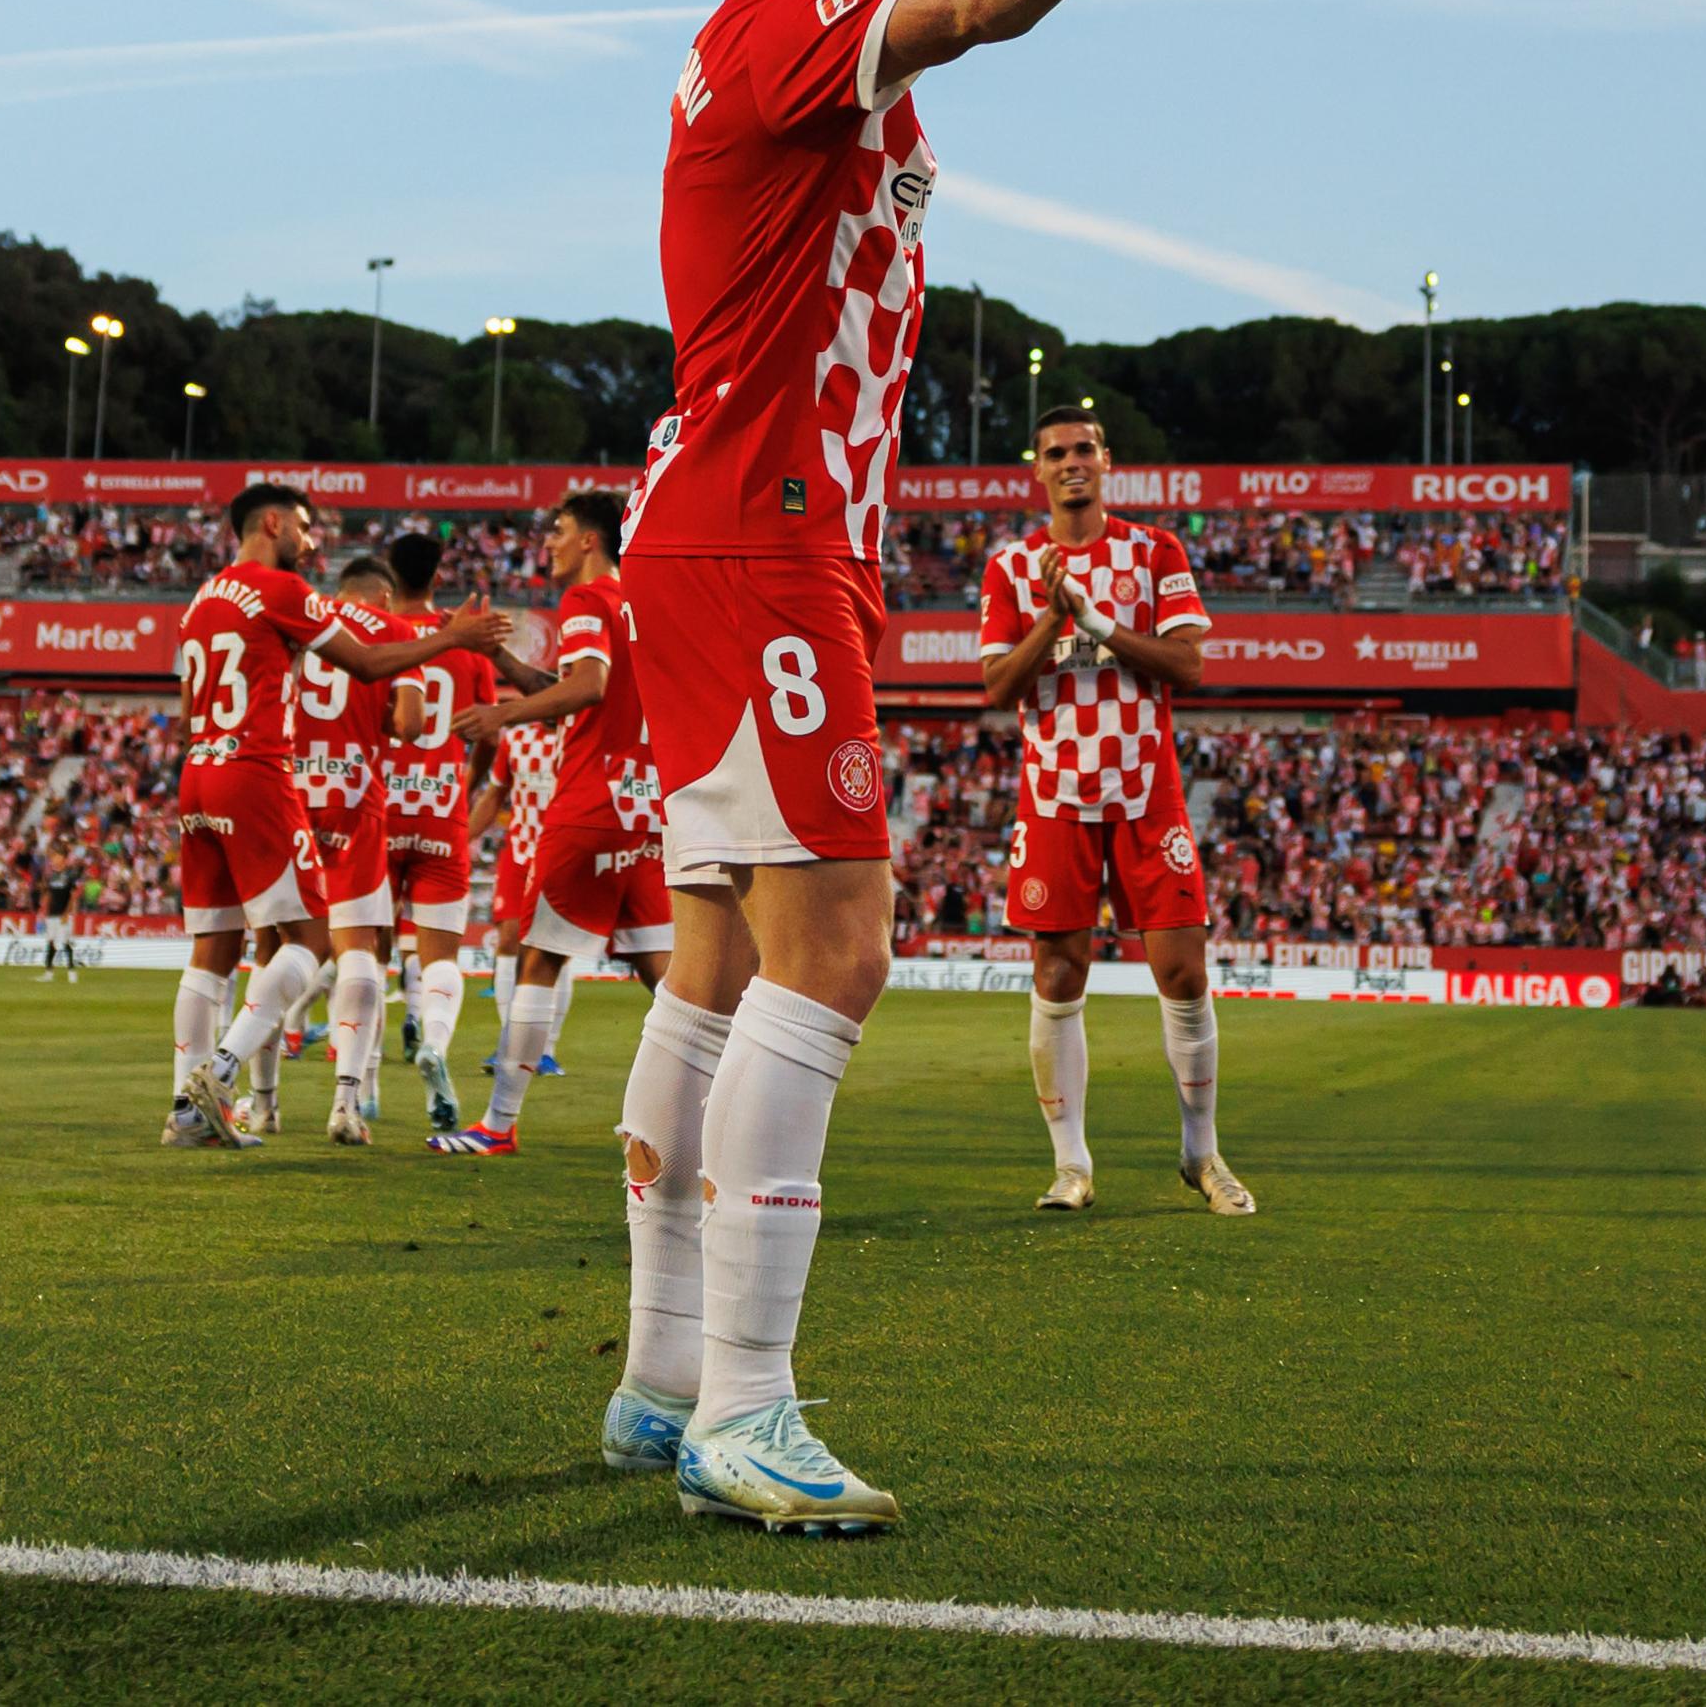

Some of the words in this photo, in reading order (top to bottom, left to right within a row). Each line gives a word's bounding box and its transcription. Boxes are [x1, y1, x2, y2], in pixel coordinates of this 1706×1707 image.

[899, 478, 1031, 500] NISSAN
[1101, 471, 1164, 505] RONA
[1168, 471, 1202, 506] FC
[1240, 471, 1311, 494] HYLO
[1411, 474, 1549, 503] RICOH
[339, 602, 387, 635] RUIZ
[36, 621, 138, 652] Marlex
[1200, 638, 1326, 662] ETIHAD
[1383, 640, 1479, 661] ESTRELLA
[181, 631, 248, 735] 23
[301, 650, 350, 721] 9
[762, 635, 828, 737] 8
[294, 754, 353, 777] arlex
[838, 744, 871, 761] GIRONA
[619, 775, 661, 797] Marl
[182, 814, 234, 836] palem
[1010, 821, 1028, 869] 3
[1204, 942, 1267, 969] RONA
[945, 967, 970, 991] de
[980, 965, 1034, 993] form
[1451, 974, 1571, 1007] LALIGA
[751, 1195, 821, 1209] GIRONA
